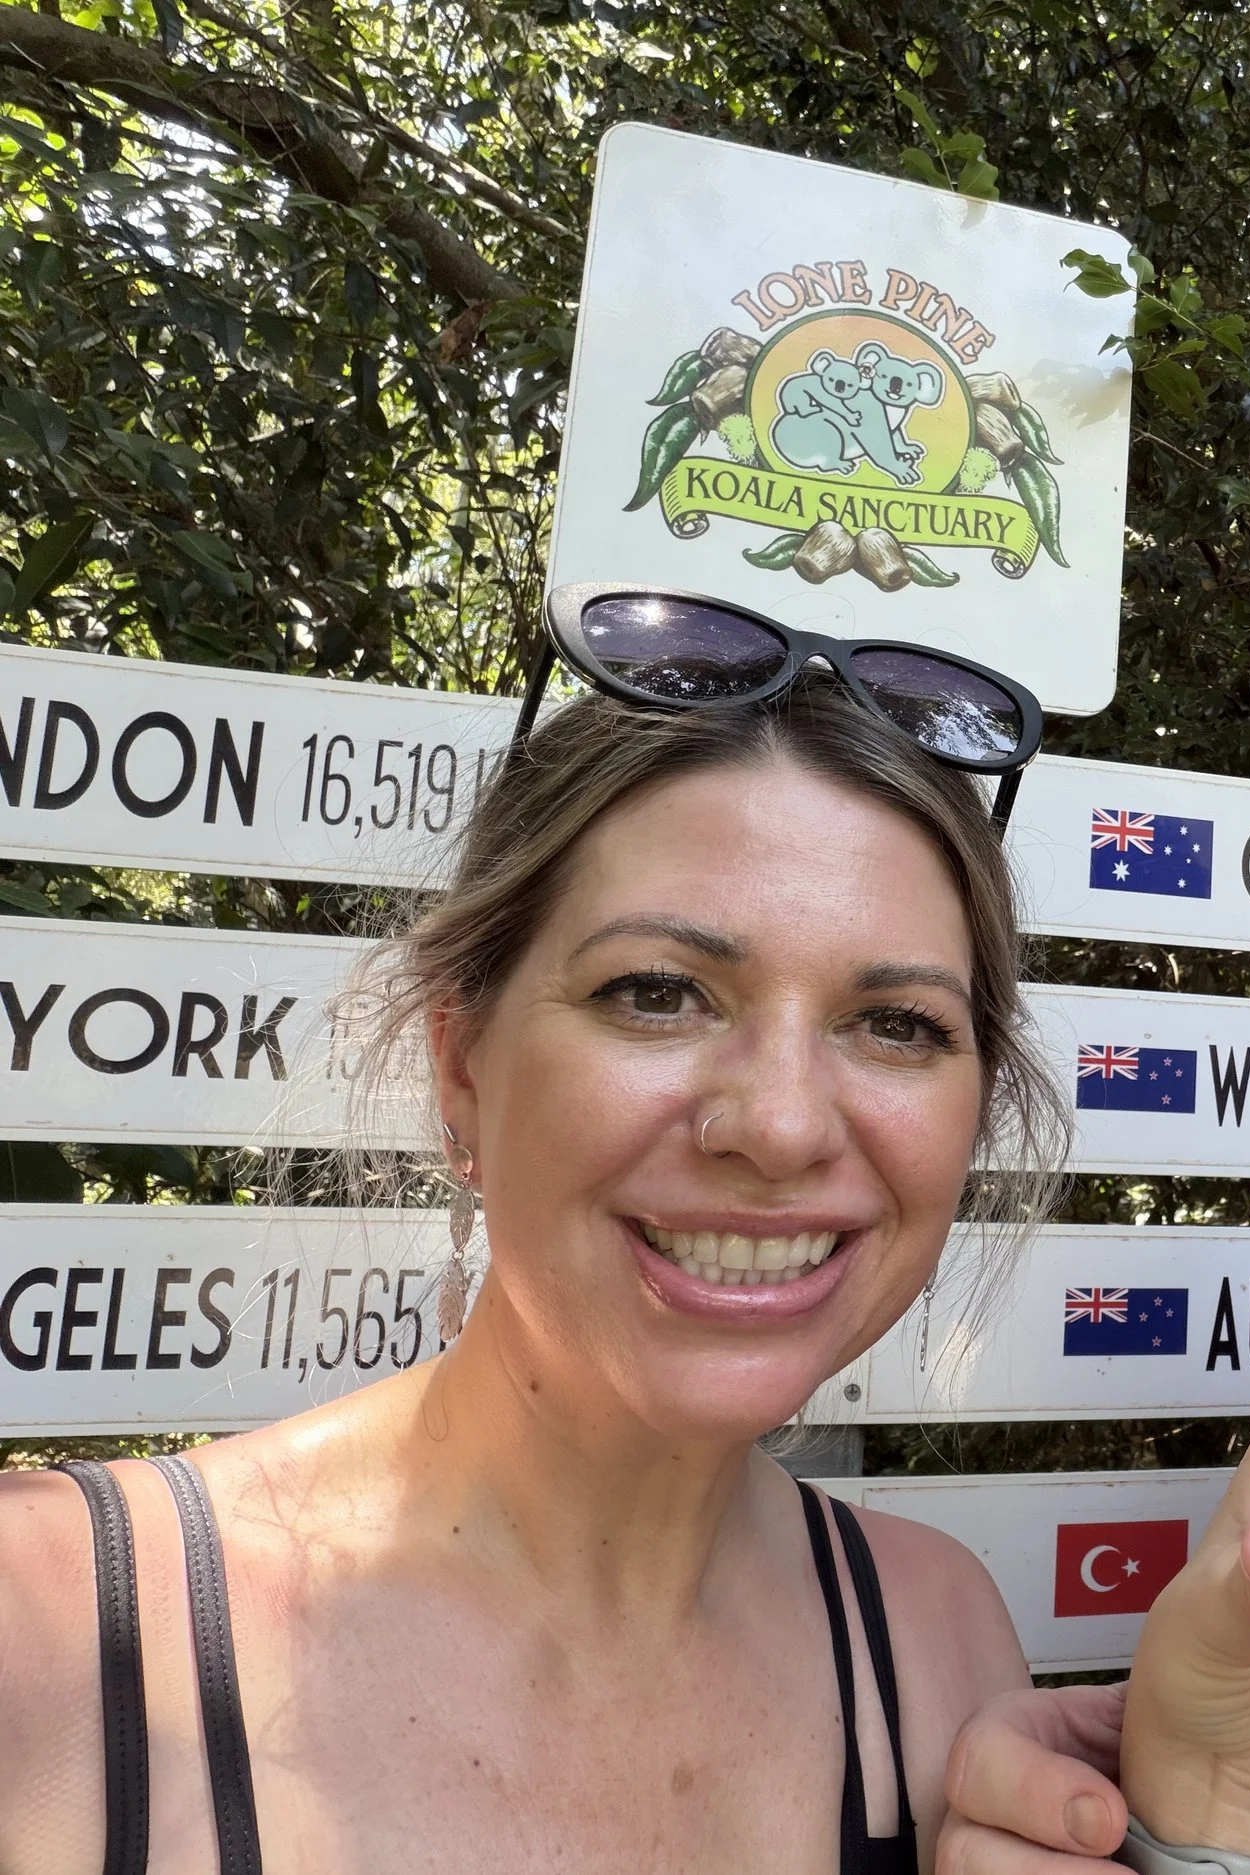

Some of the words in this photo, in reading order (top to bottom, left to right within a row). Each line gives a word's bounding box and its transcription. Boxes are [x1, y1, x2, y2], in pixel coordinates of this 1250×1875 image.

[731, 260, 872, 331] LONE
[880, 268, 996, 365] PINE
[685, 467, 806, 518] KOALA
[816, 492, 1016, 544] SANCTUARY
[301, 733, 457, 839] 16,519
[0, 981, 298, 1081] YORK
[0, 1267, 234, 1371] GELES
[260, 1268, 425, 1383] 11,565
